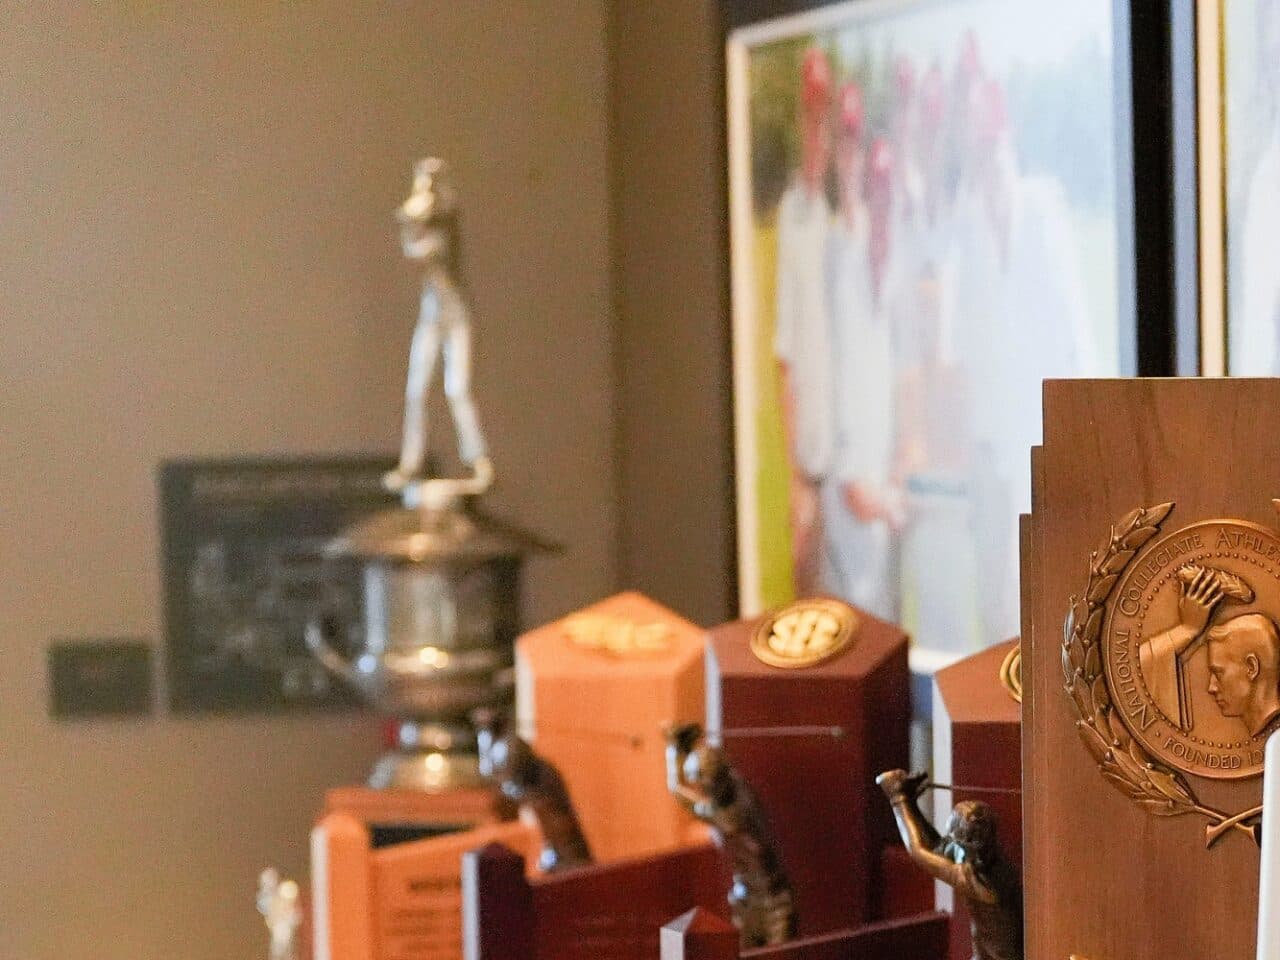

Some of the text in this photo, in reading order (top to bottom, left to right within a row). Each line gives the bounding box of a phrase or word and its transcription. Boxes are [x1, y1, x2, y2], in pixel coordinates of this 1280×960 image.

[1120, 535, 1204, 616] COLLEGIATE
[1115, 629, 1157, 731] NATIONAL
[1163, 737, 1241, 769] FOUNDED
